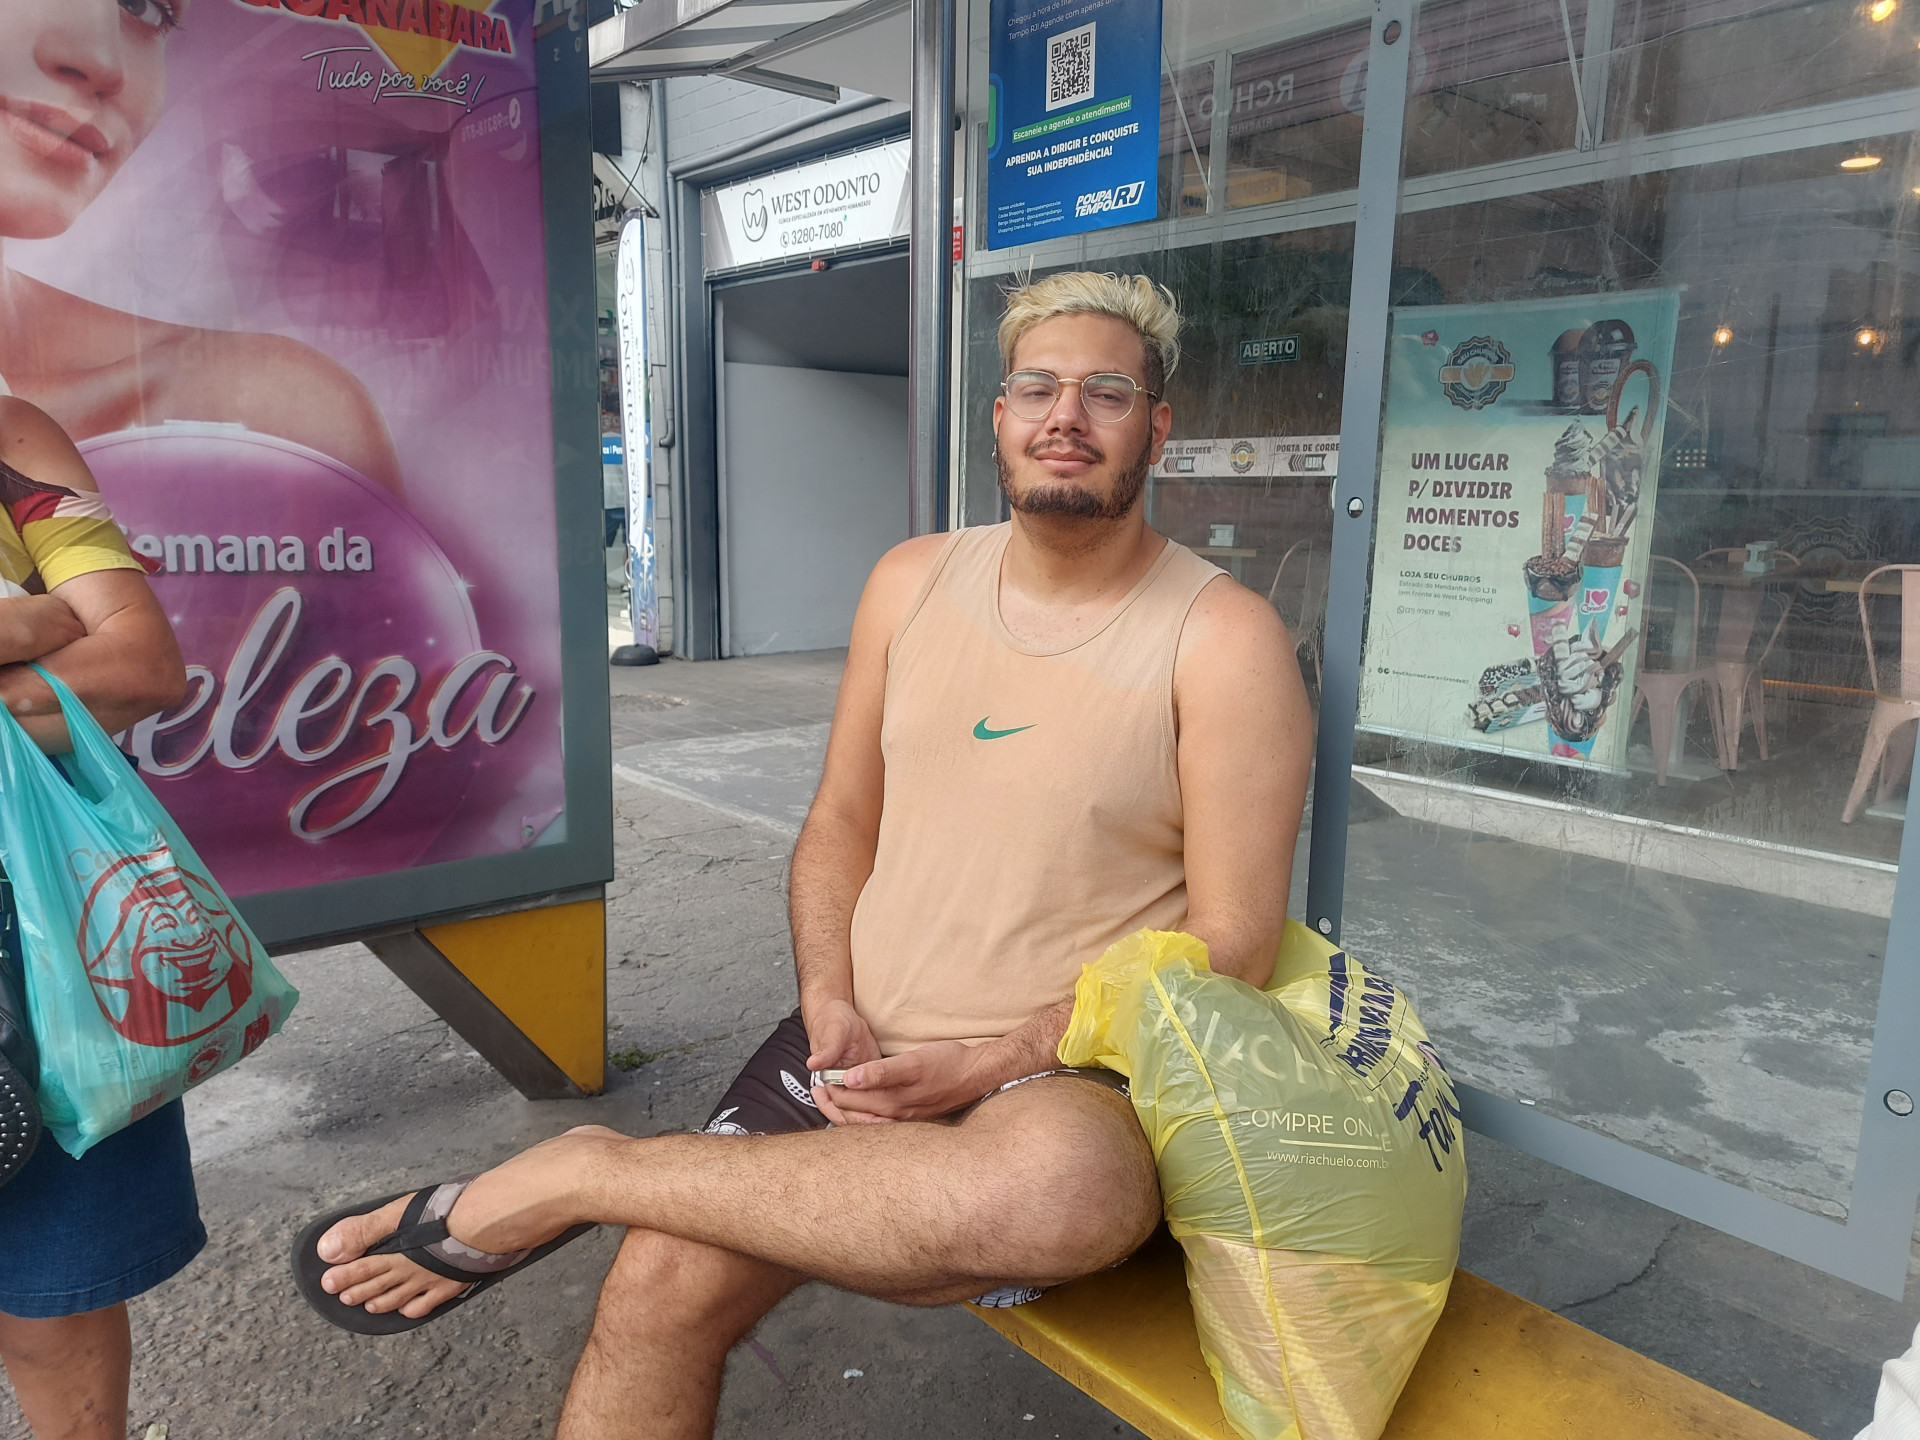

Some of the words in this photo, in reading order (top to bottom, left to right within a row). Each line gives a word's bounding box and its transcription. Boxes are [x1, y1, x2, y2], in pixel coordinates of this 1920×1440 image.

[1007, 13, 1032, 27] Chegou
[1037, 6, 1050, 17] hora
[1051, 1, 1060, 11] de
[1008, 28, 1030, 41] Tempo
[1040, 15, 1065, 29] Agende
[1065, 9, 1080, 20] com
[1081, 1, 1104, 15] apenas
[302, 46, 373, 91] Tudo
[372, 68, 415, 103] por
[421, 73, 486, 114] você!
[1013, 126, 1042, 141] Escaneie
[1043, 124, 1048, 132] e
[1049, 117, 1075, 131] agende
[1081, 99, 1130, 121] atendimento!
[1005, 149, 1041, 168] APRENDA
[1043, 147, 1050, 158] A
[1051, 138, 1081, 156] DIRIGIR
[1082, 136, 1088, 147] E
[1089, 122, 1139, 145] CONQUISTE
[1027, 163, 1043, 177] SUA
[1044, 145, 1113, 173] INDEPENDÊNCIA!
[771, 189, 811, 216] WEST
[813, 172, 881, 207] ODONTO
[1076, 189, 1112, 207] POUPA
[1114, 183, 1143, 207] RJ
[1075, 201, 1114, 218] TEMPO
[791, 220, 843, 245] 3280-7080
[1242, 339, 1296, 358] ABERTO
[1175, 446, 1184, 455] DE
[1185, 446, 1212, 455] CORRER
[1276, 444, 1300, 453] PORTA
[1302, 443, 1312, 452] DE
[1411, 453, 1440, 470] UM
[1444, 453, 1509, 471] LUGAR
[1408, 478, 1429, 499] P/
[1432, 480, 1513, 500] DIVIDIR
[1406, 507, 1520, 528] MOMENTOS
[118, 524, 305, 573] emana
[318, 527, 373, 572] da
[1403, 533, 1462, 553] DOCES
[1400, 570, 1421, 579] LOJA
[1423, 571, 1439, 580] SEU
[1442, 593, 1457, 601] West
[114, 586, 535, 840] eleza
[1237, 1107, 1336, 1136] COMPRE
